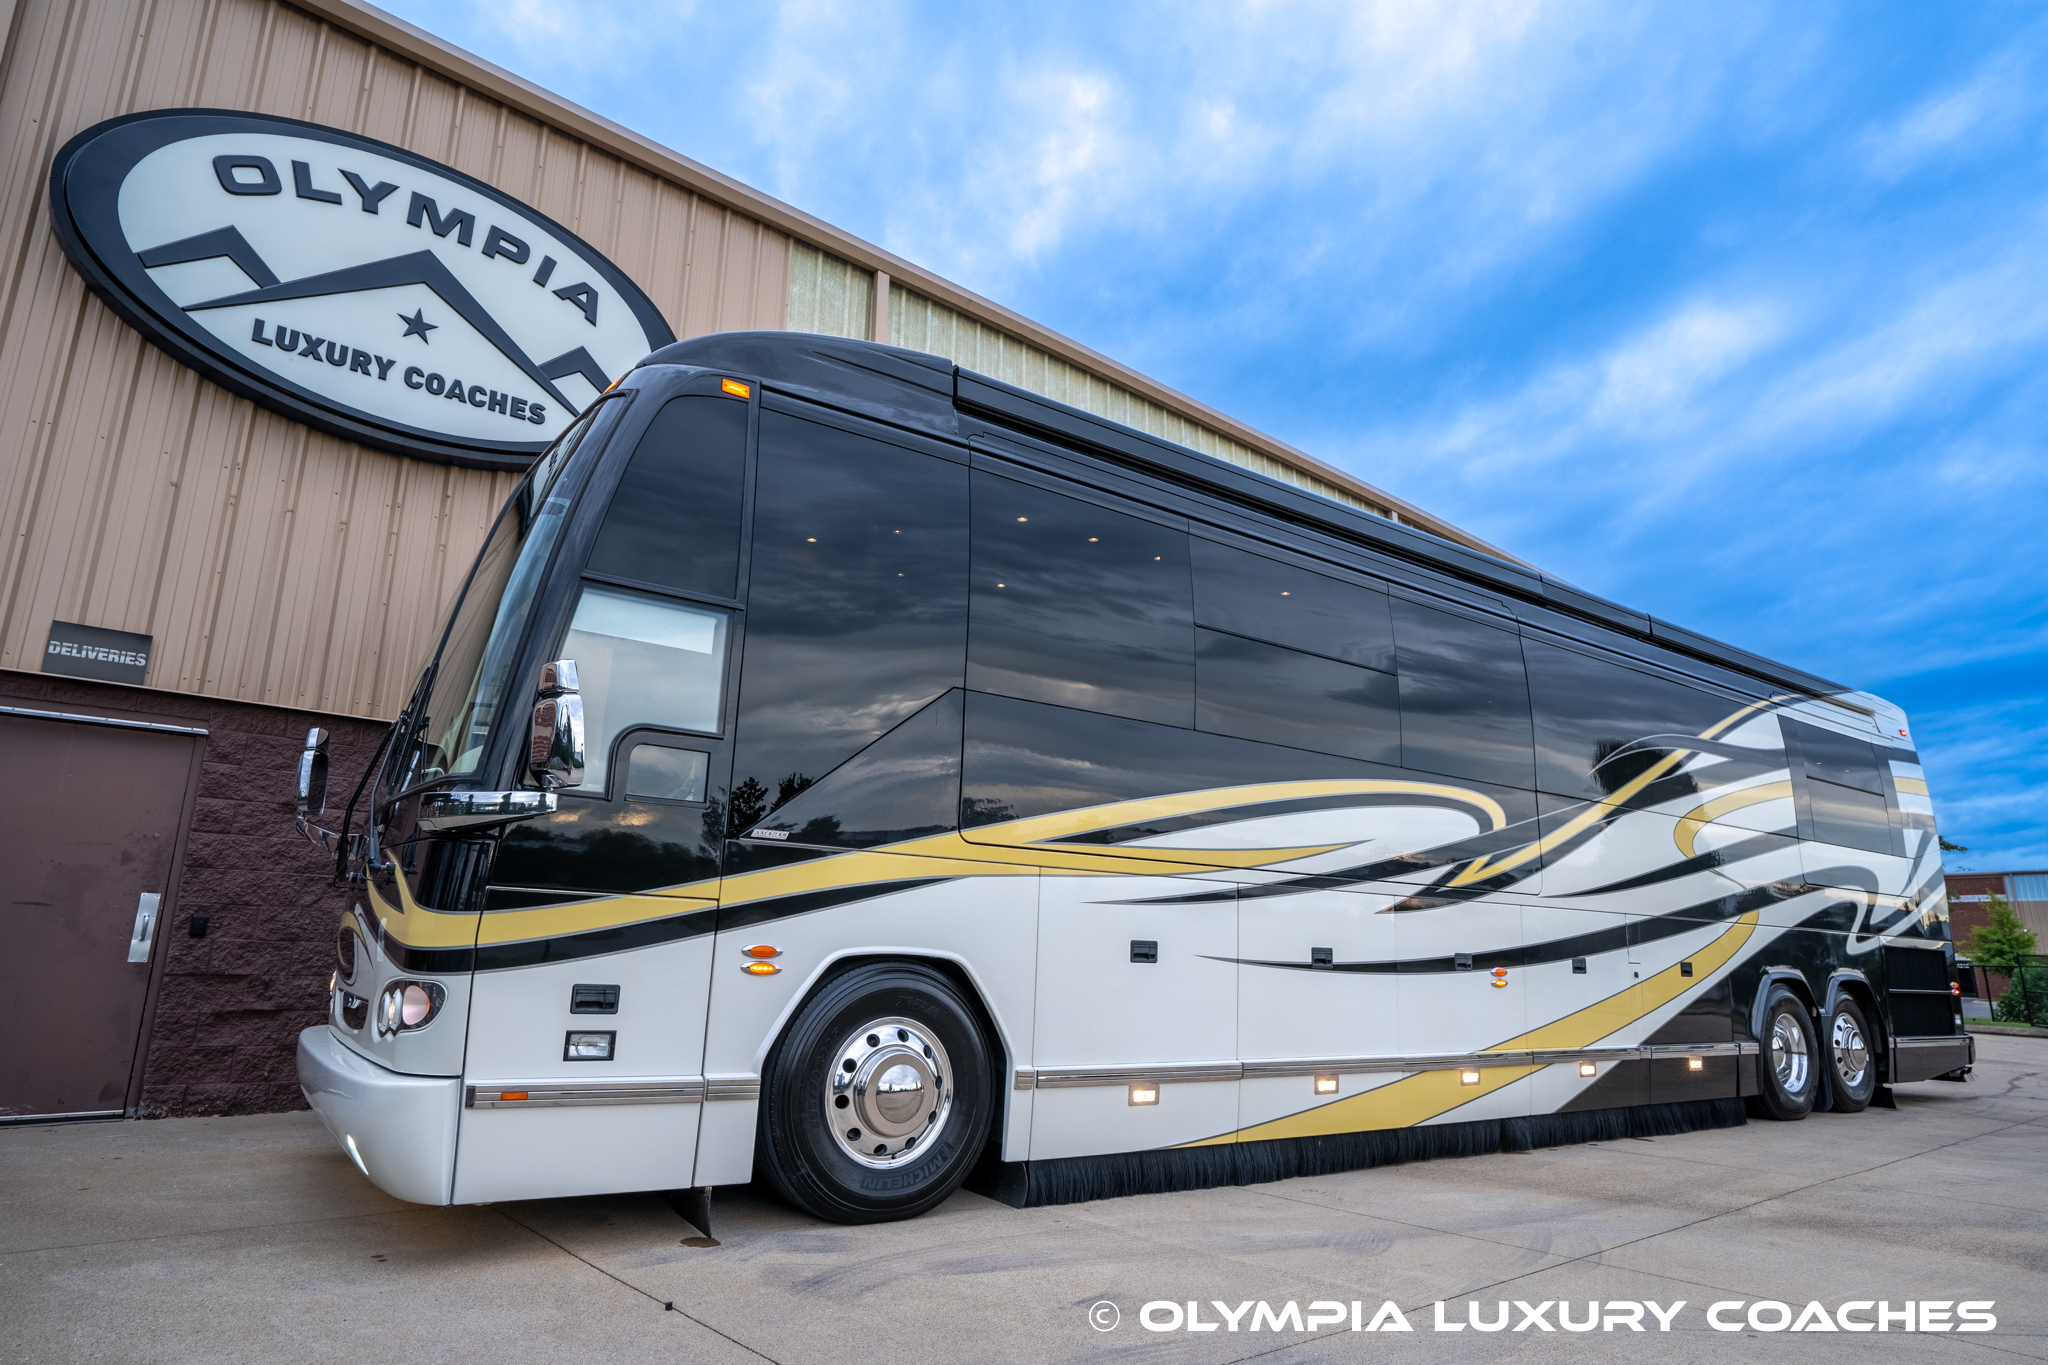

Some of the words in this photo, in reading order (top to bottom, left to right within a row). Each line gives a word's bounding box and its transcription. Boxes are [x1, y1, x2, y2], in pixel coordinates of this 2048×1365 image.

[212, 154, 600, 328] OLYMPIA
[251, 317, 396, 382] LUXURY
[403, 366, 546, 426] COACHES
[48, 640, 147, 667] DELIVERIES
[862, 1153, 943, 1189] MICHELIN
